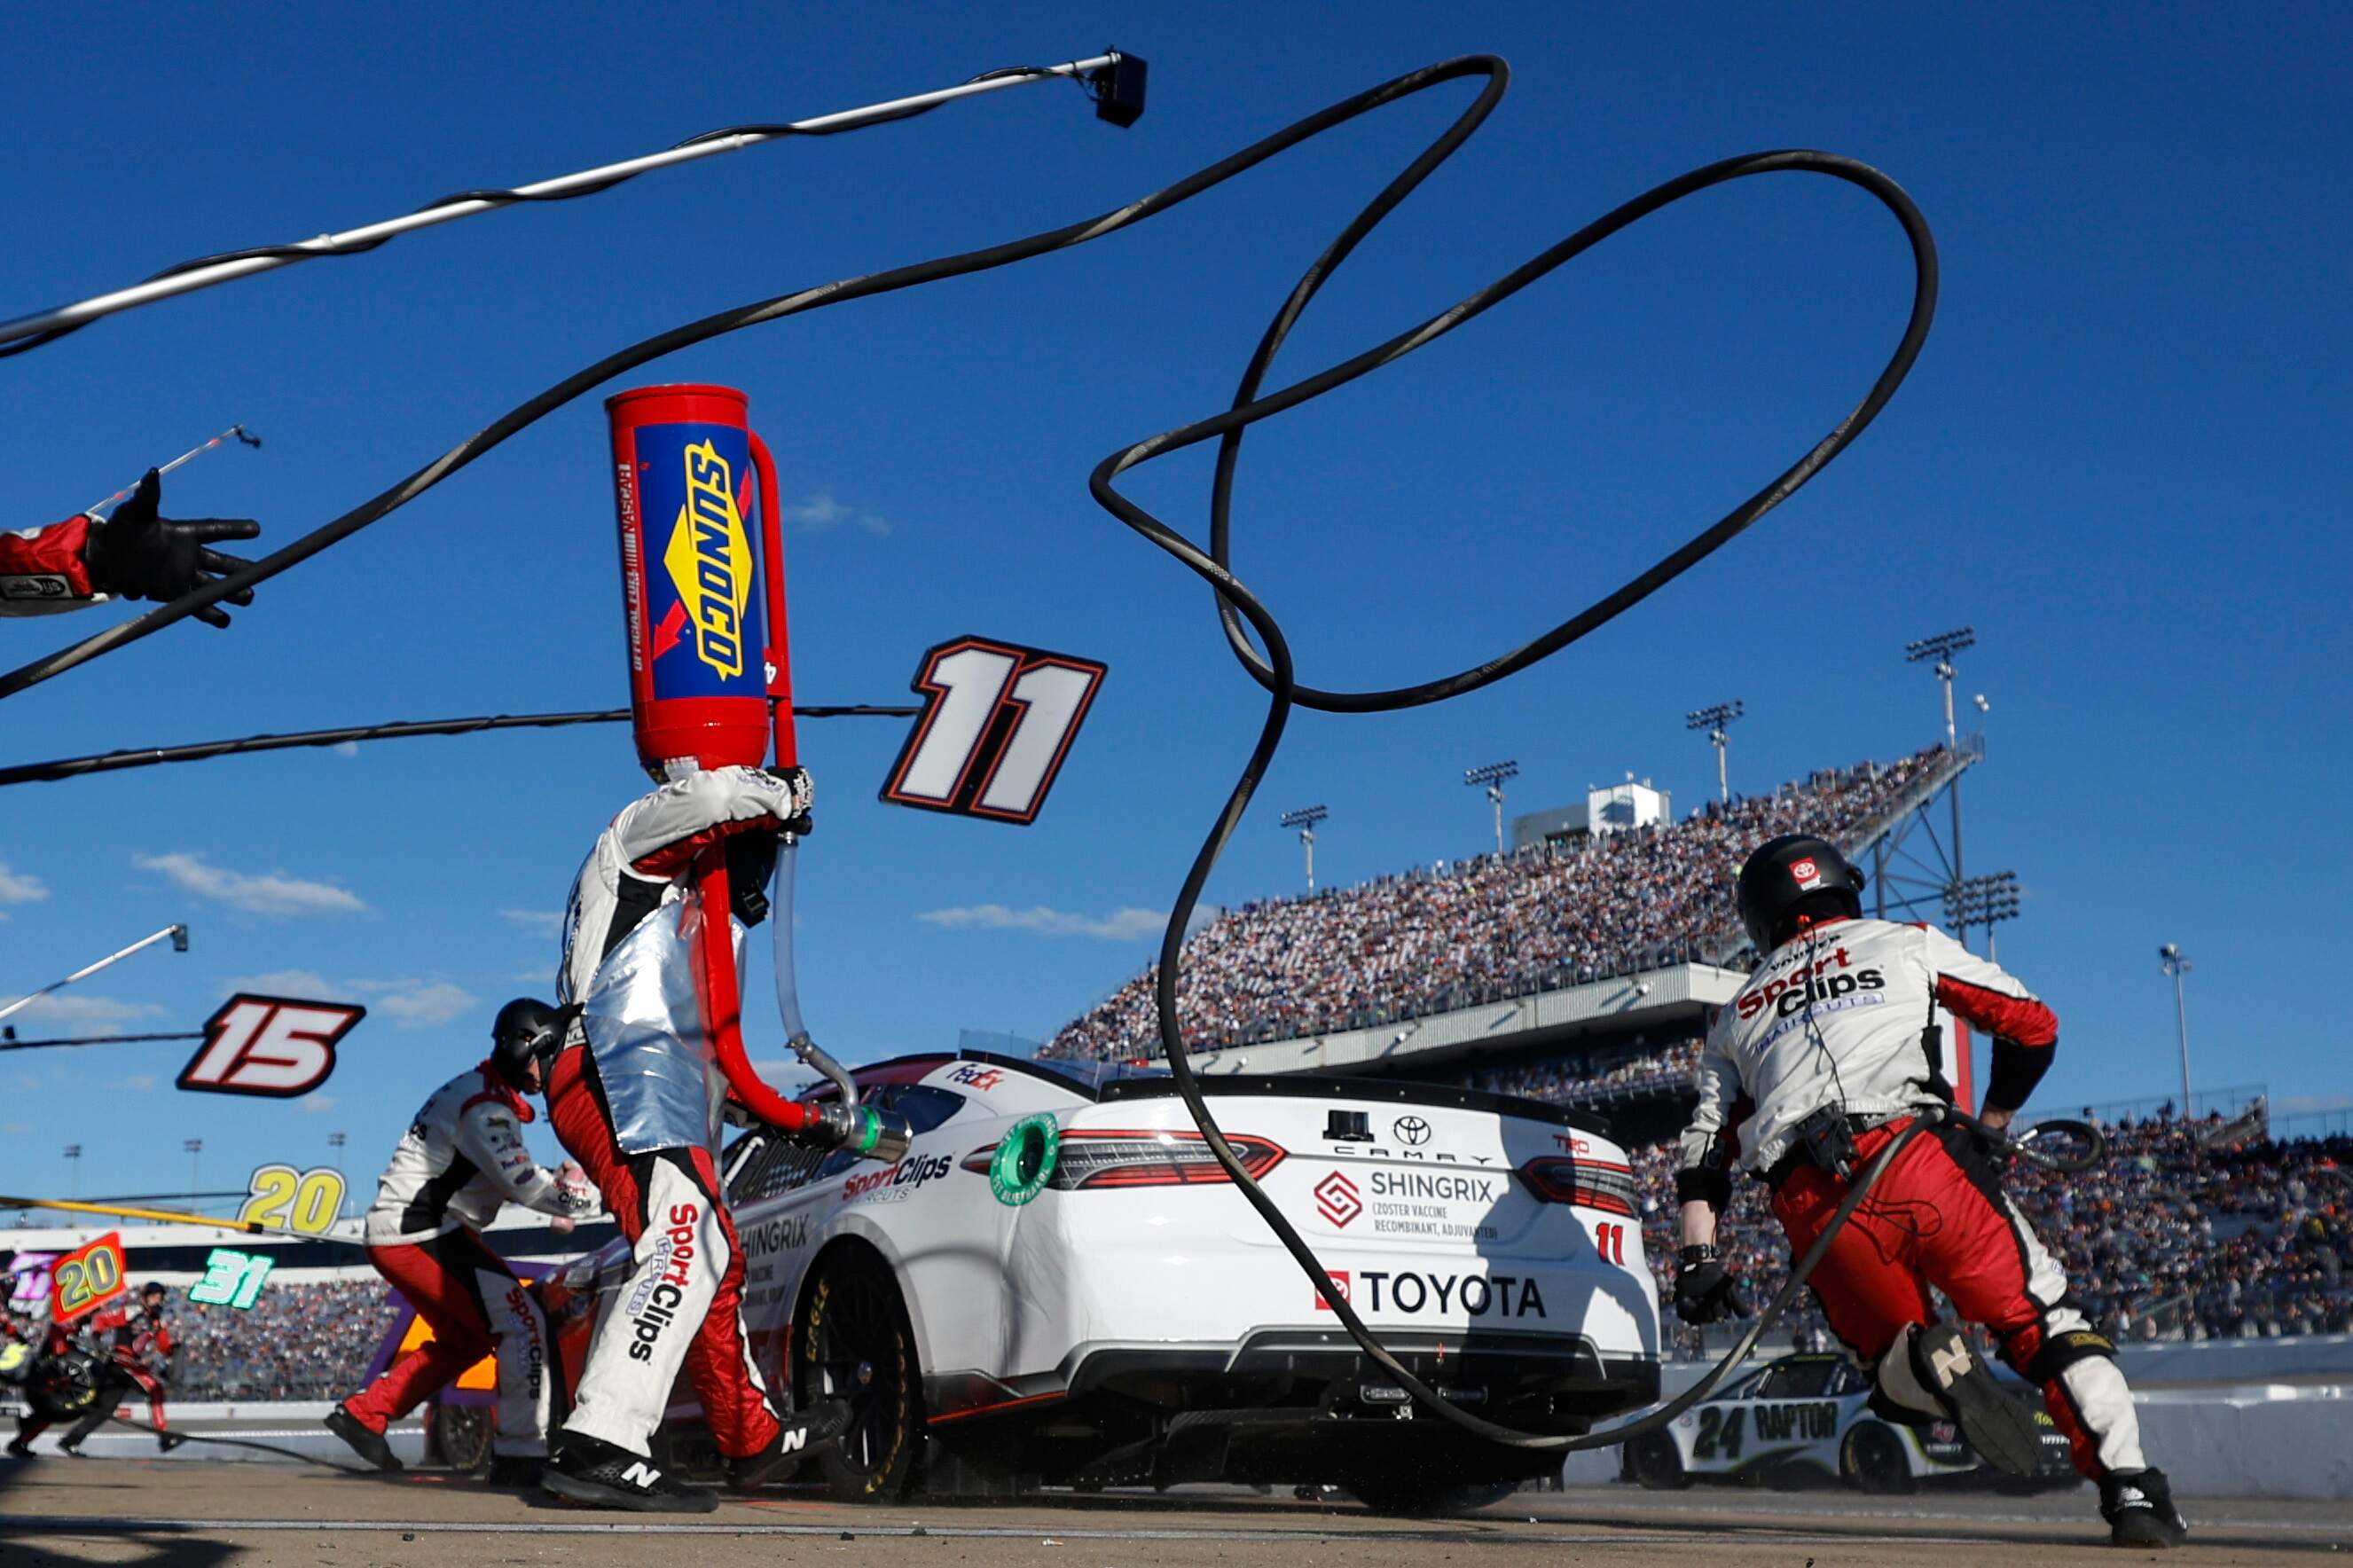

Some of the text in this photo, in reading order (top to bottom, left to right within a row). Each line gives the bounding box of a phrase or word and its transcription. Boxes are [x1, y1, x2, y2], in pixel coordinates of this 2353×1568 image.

[618, 463, 635, 532] NASCAR
[690, 448, 738, 670] SUNOCO
[887, 640, 1105, 821] 11
[1737, 946, 1852, 1020] Sport
[1777, 968, 1886, 1018] Clips
[184, 1000, 355, 1092] 15
[946, 1063, 1004, 1091] FedEx
[1334, 1146, 1493, 1164] CAMRY
[239, 1169, 344, 1235] 20
[1371, 1172, 1494, 1203] SHINGRIX
[1413, 1205, 1447, 1219] VACCINE
[740, 1212, 809, 1259] HINGRIX
[1596, 1222, 1625, 1266] 11
[55, 1246, 118, 1313] 20
[189, 1249, 273, 1310] 31
[1360, 1271, 1547, 1318] TOYOTA
[1692, 1401, 1839, 1460] 24 RAPTOR
